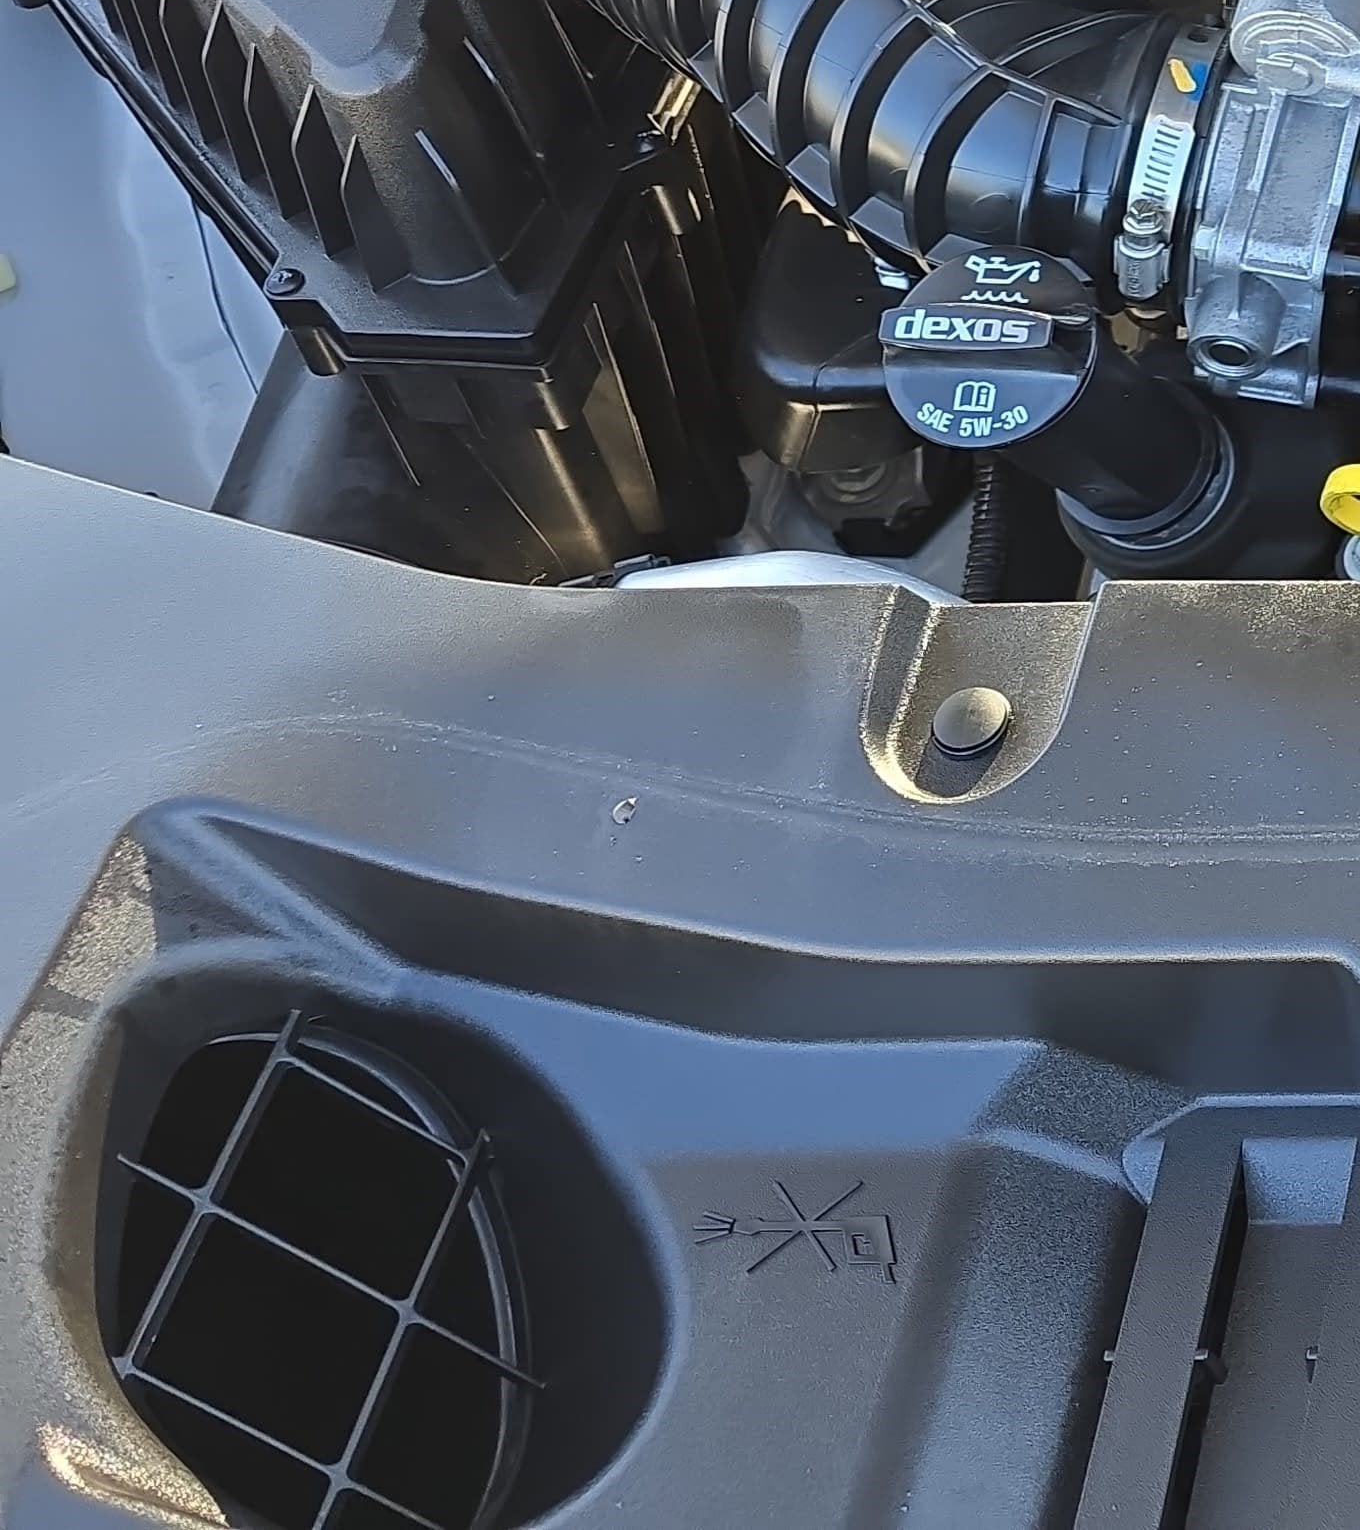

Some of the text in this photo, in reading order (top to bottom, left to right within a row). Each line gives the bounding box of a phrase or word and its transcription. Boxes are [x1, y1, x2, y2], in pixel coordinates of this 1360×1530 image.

[894, 309, 1037, 344] dexos
[916, 402, 1029, 437] SAE 5W-30
